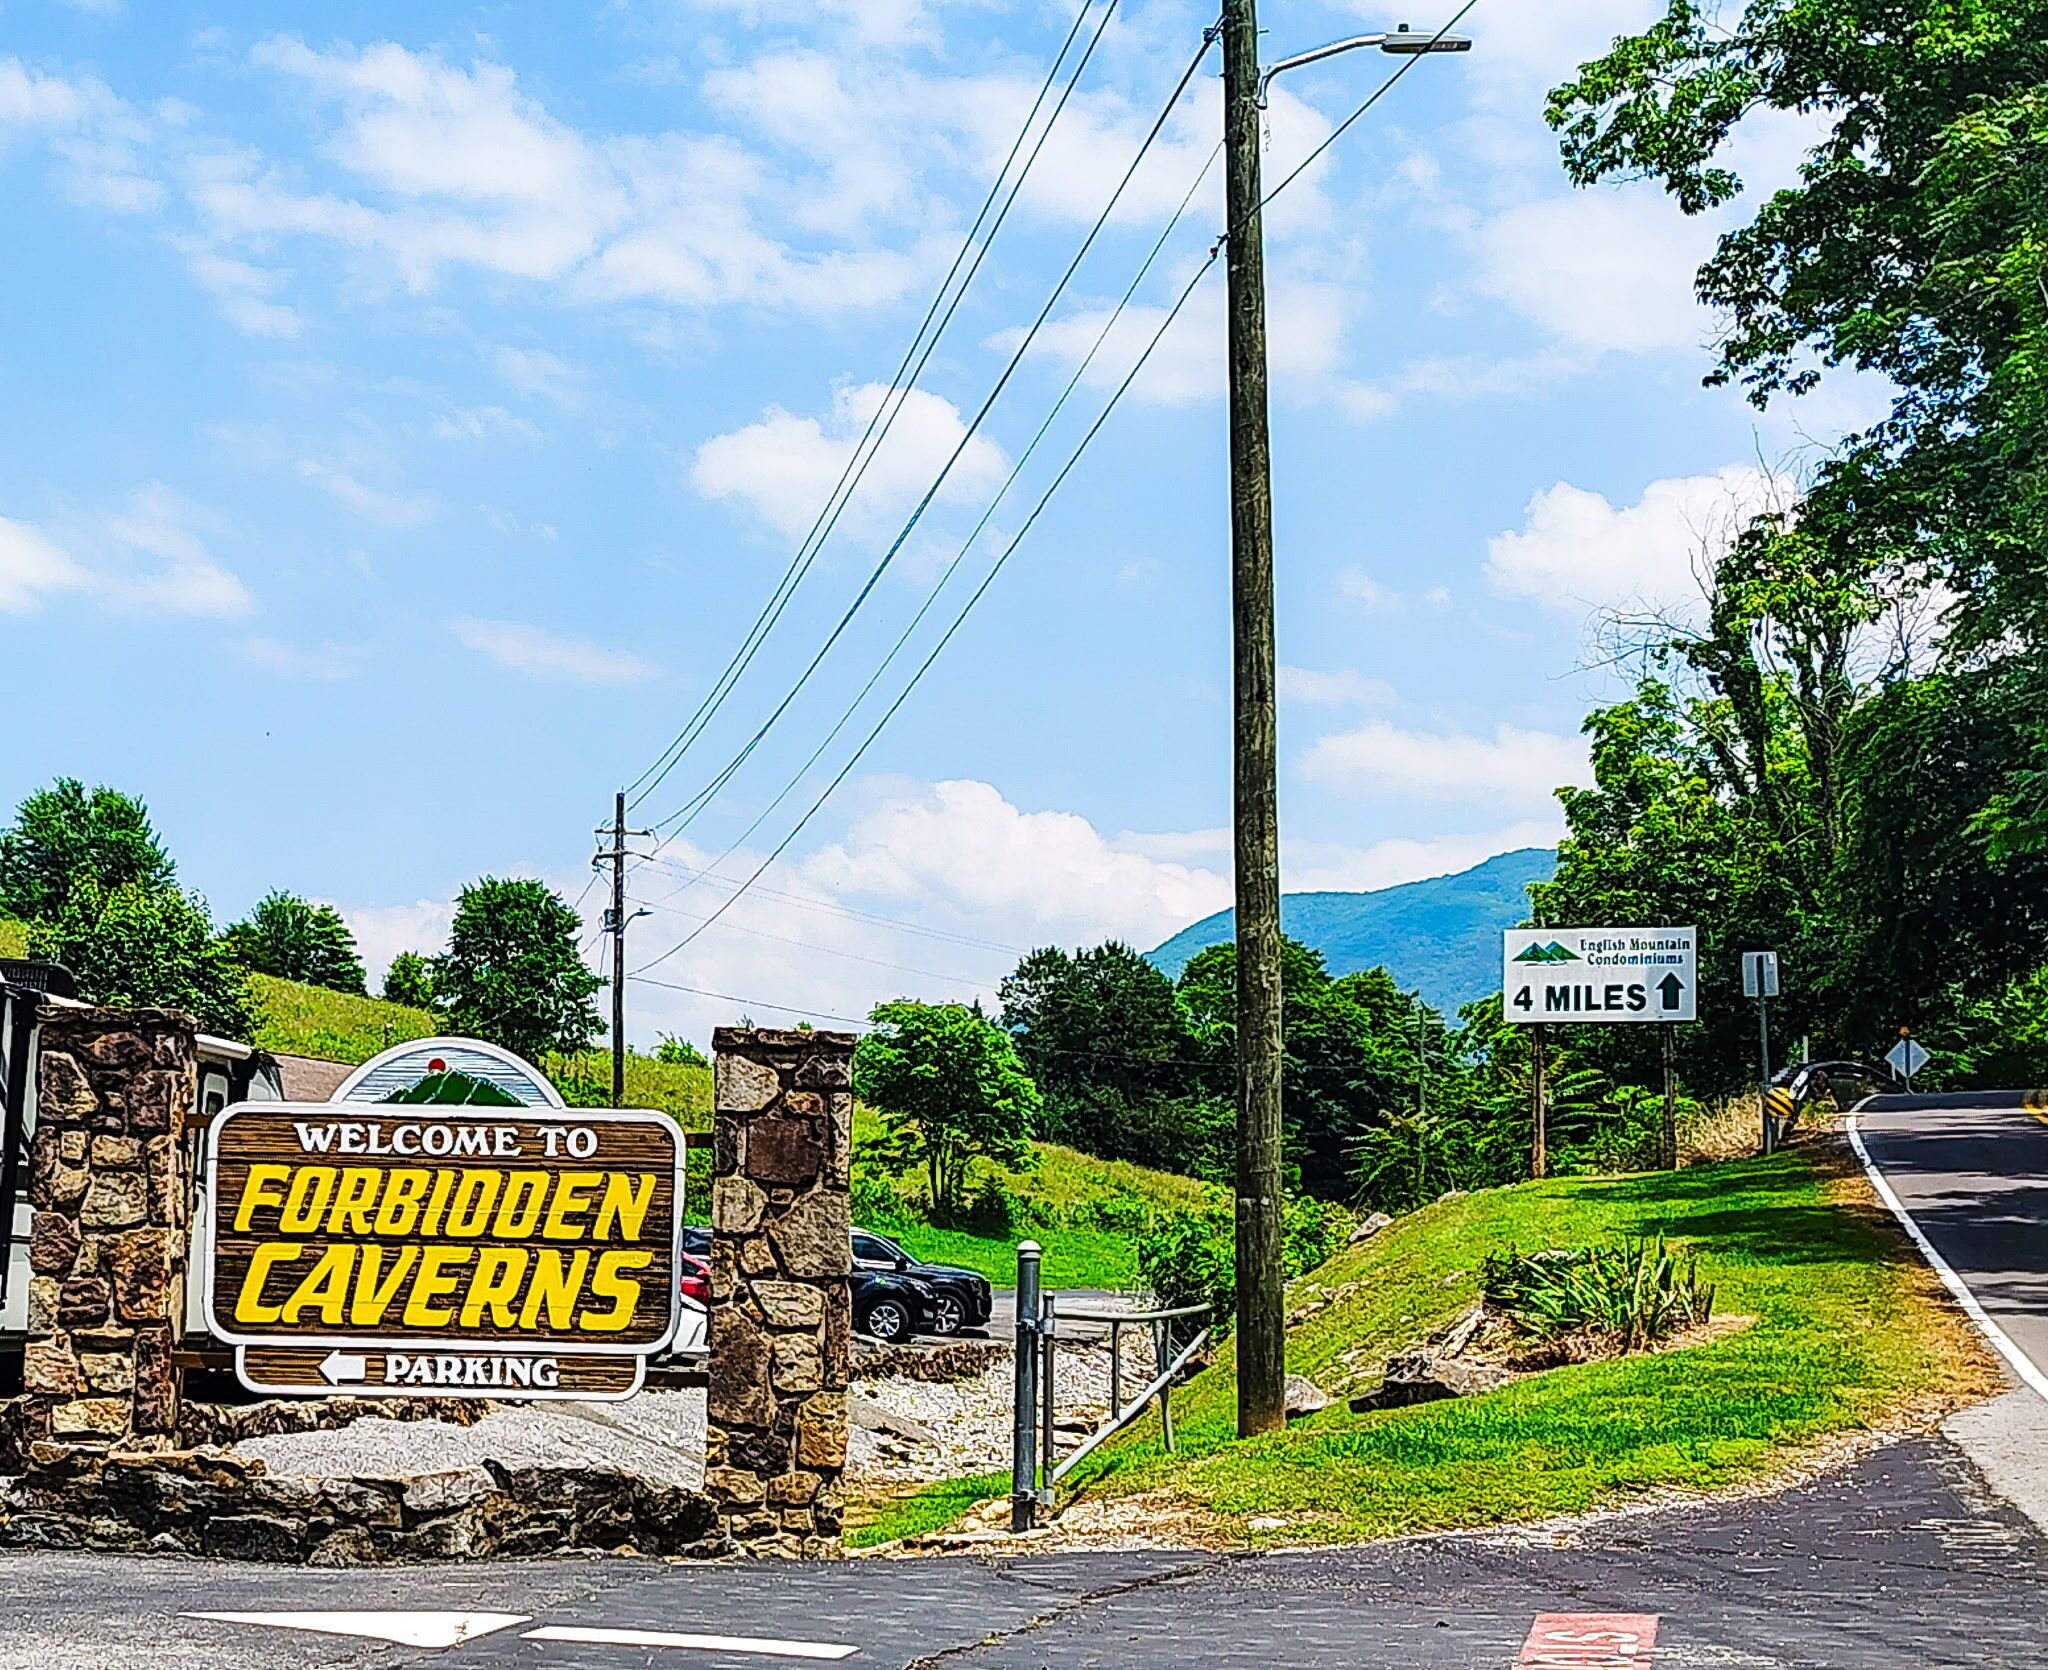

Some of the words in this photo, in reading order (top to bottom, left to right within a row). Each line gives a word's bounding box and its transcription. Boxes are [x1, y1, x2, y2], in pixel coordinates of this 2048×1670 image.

[1579, 938, 1625, 953] English
[1629, 937, 1691, 951] Mountain
[1587, 953, 1685, 966] Condominiums
[1513, 985, 1534, 1012] 4
[1545, 984, 1647, 1012] MILES
[291, 1121, 524, 1157] WELCOME
[536, 1126, 599, 1159] TO
[233, 1163, 657, 1241] FORBIDDEN
[234, 1241, 654, 1332] CAVERNS
[384, 1354, 561, 1387] PARKING
